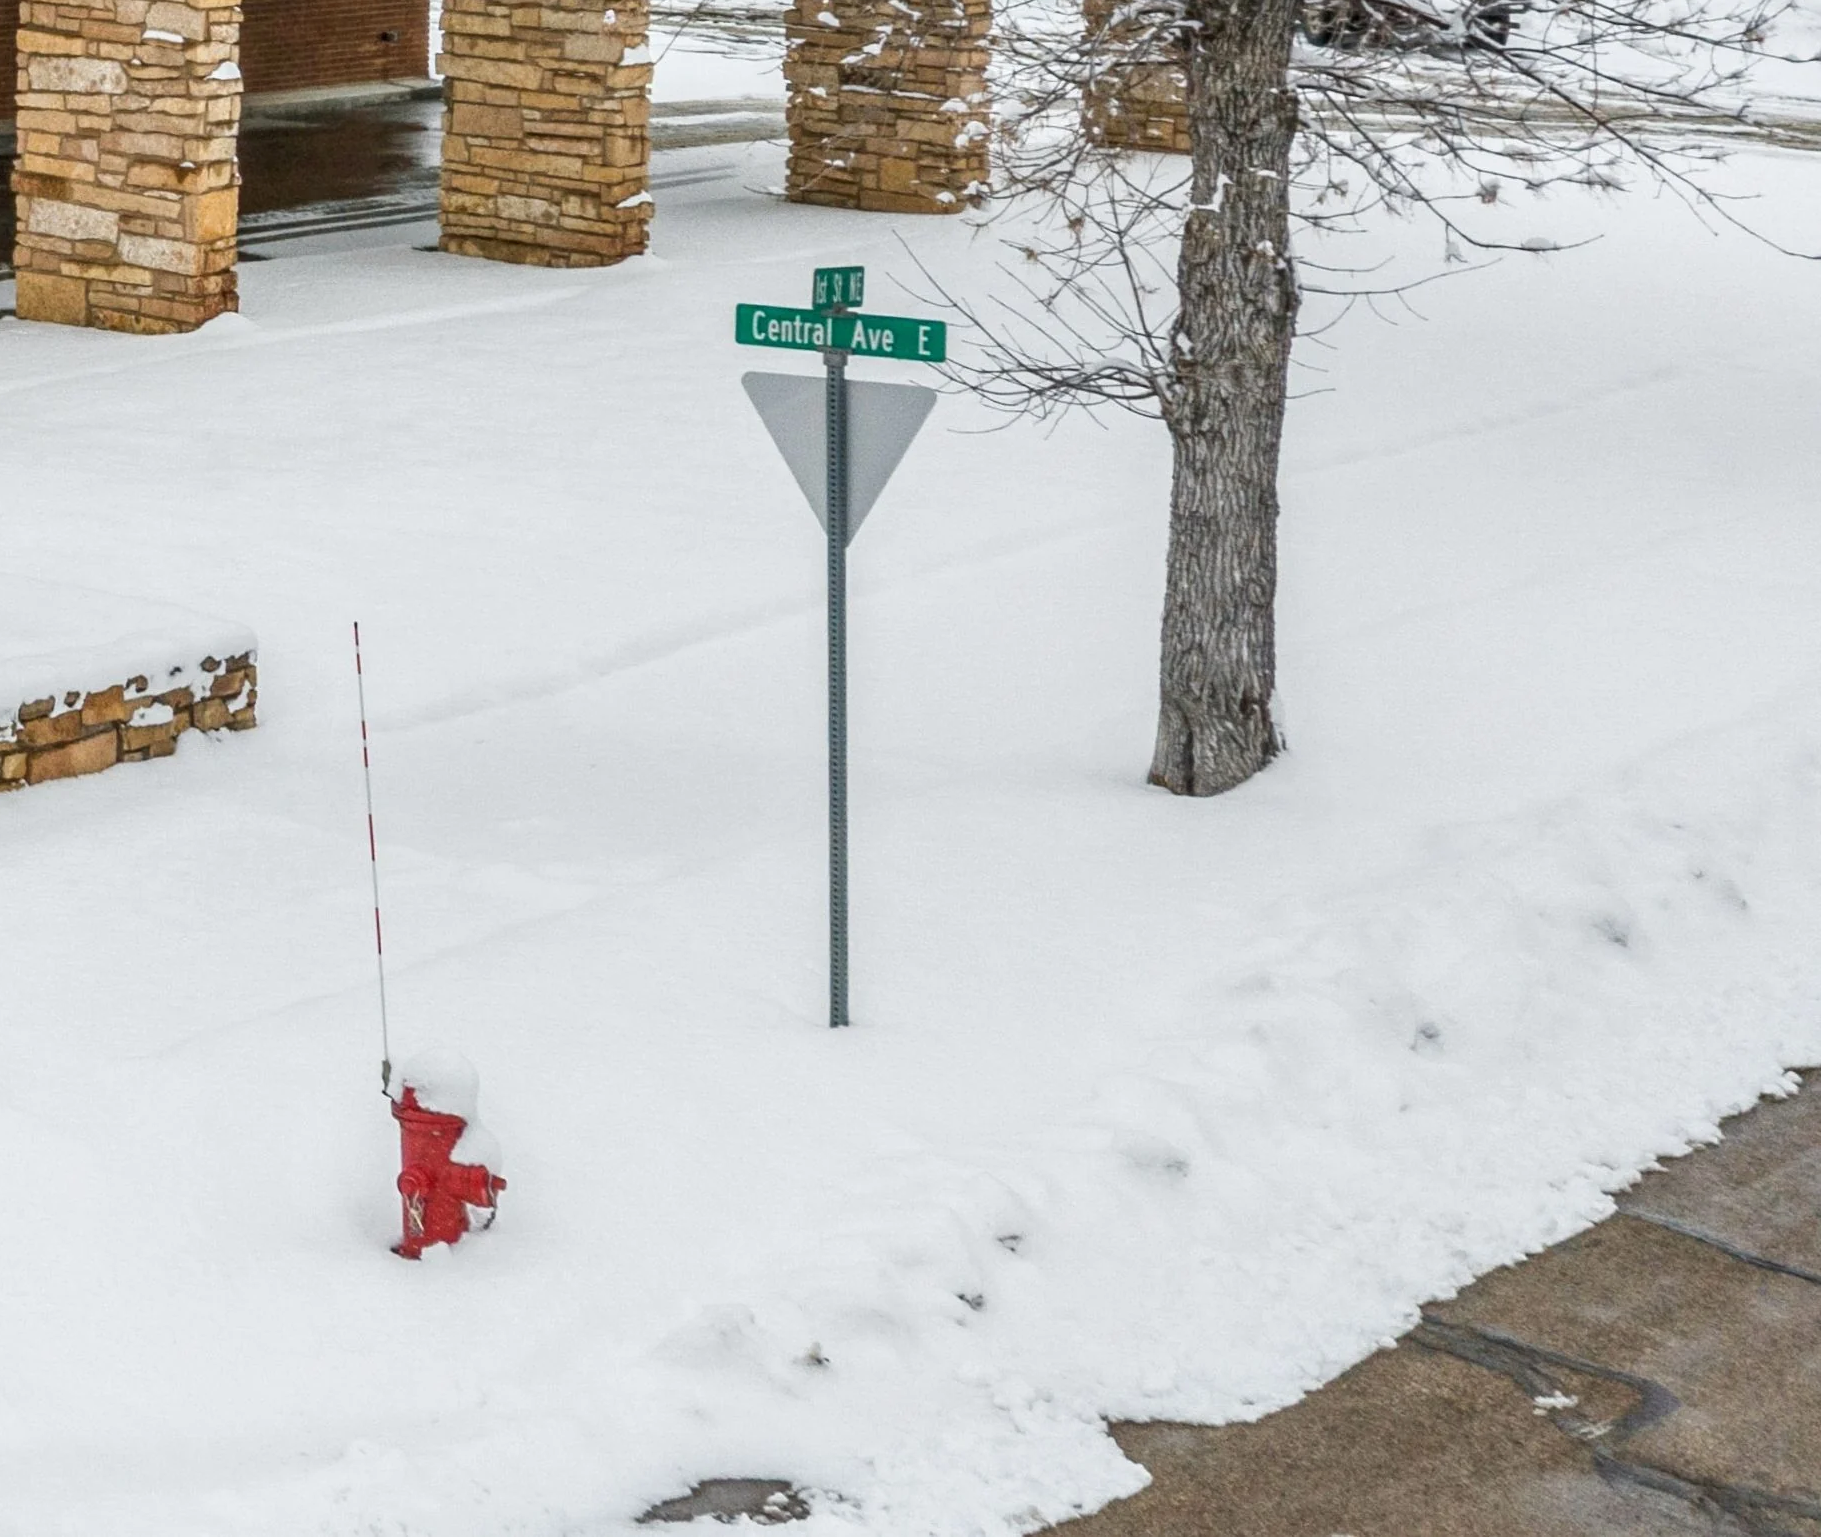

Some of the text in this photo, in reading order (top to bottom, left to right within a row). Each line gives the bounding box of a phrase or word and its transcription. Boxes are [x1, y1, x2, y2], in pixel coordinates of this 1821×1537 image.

[816, 271, 862, 304] 1st St NE
[752, 311, 932, 356] Central Ave E
